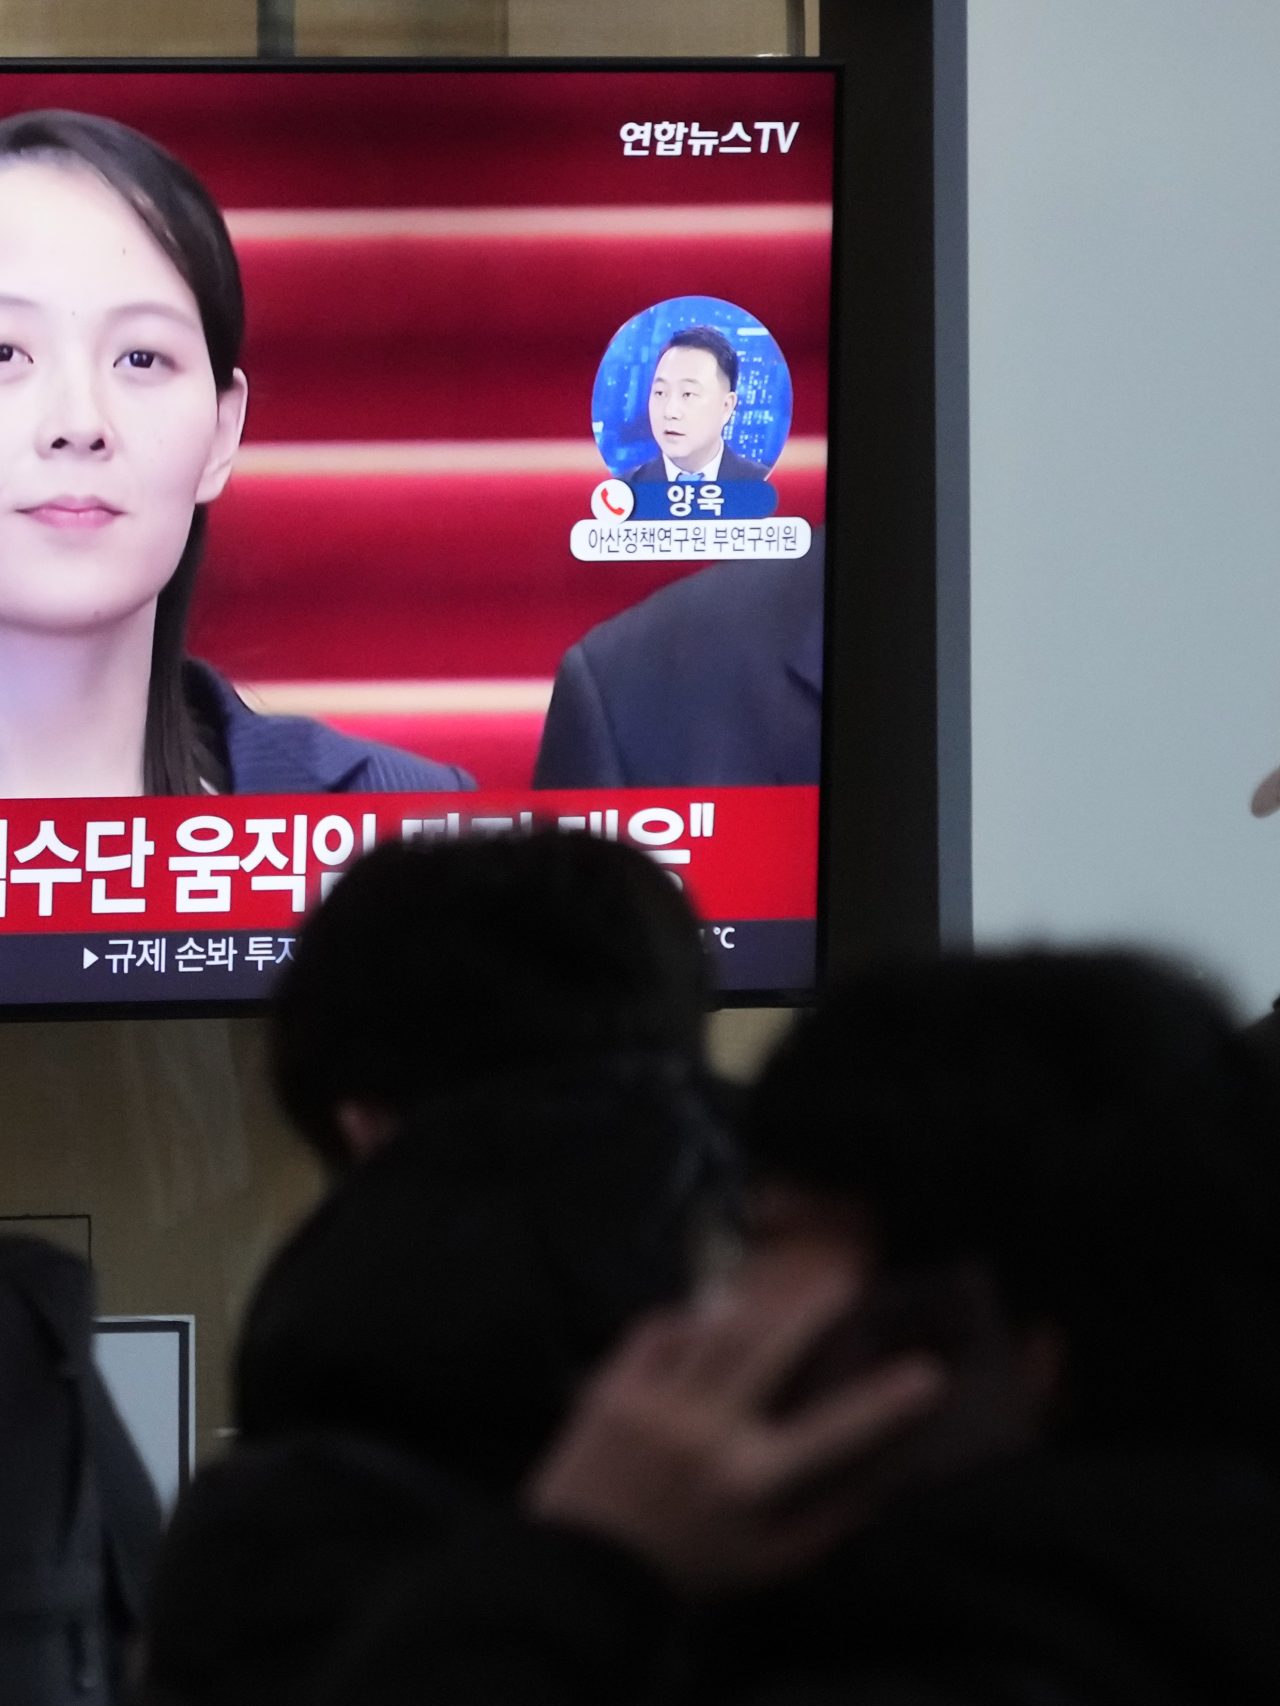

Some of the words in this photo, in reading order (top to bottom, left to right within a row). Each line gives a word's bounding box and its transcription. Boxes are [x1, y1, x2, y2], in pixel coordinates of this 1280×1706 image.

[619, 121, 800, 156] 연합뉴스TV
[667, 484, 724, 516] 양욱
[588, 527, 707, 554] 아산정책연구원
[713, 525, 797, 552] 부연구위원
[104, 938, 167, 974] 규제
[175, 936, 238, 972] 손봐
